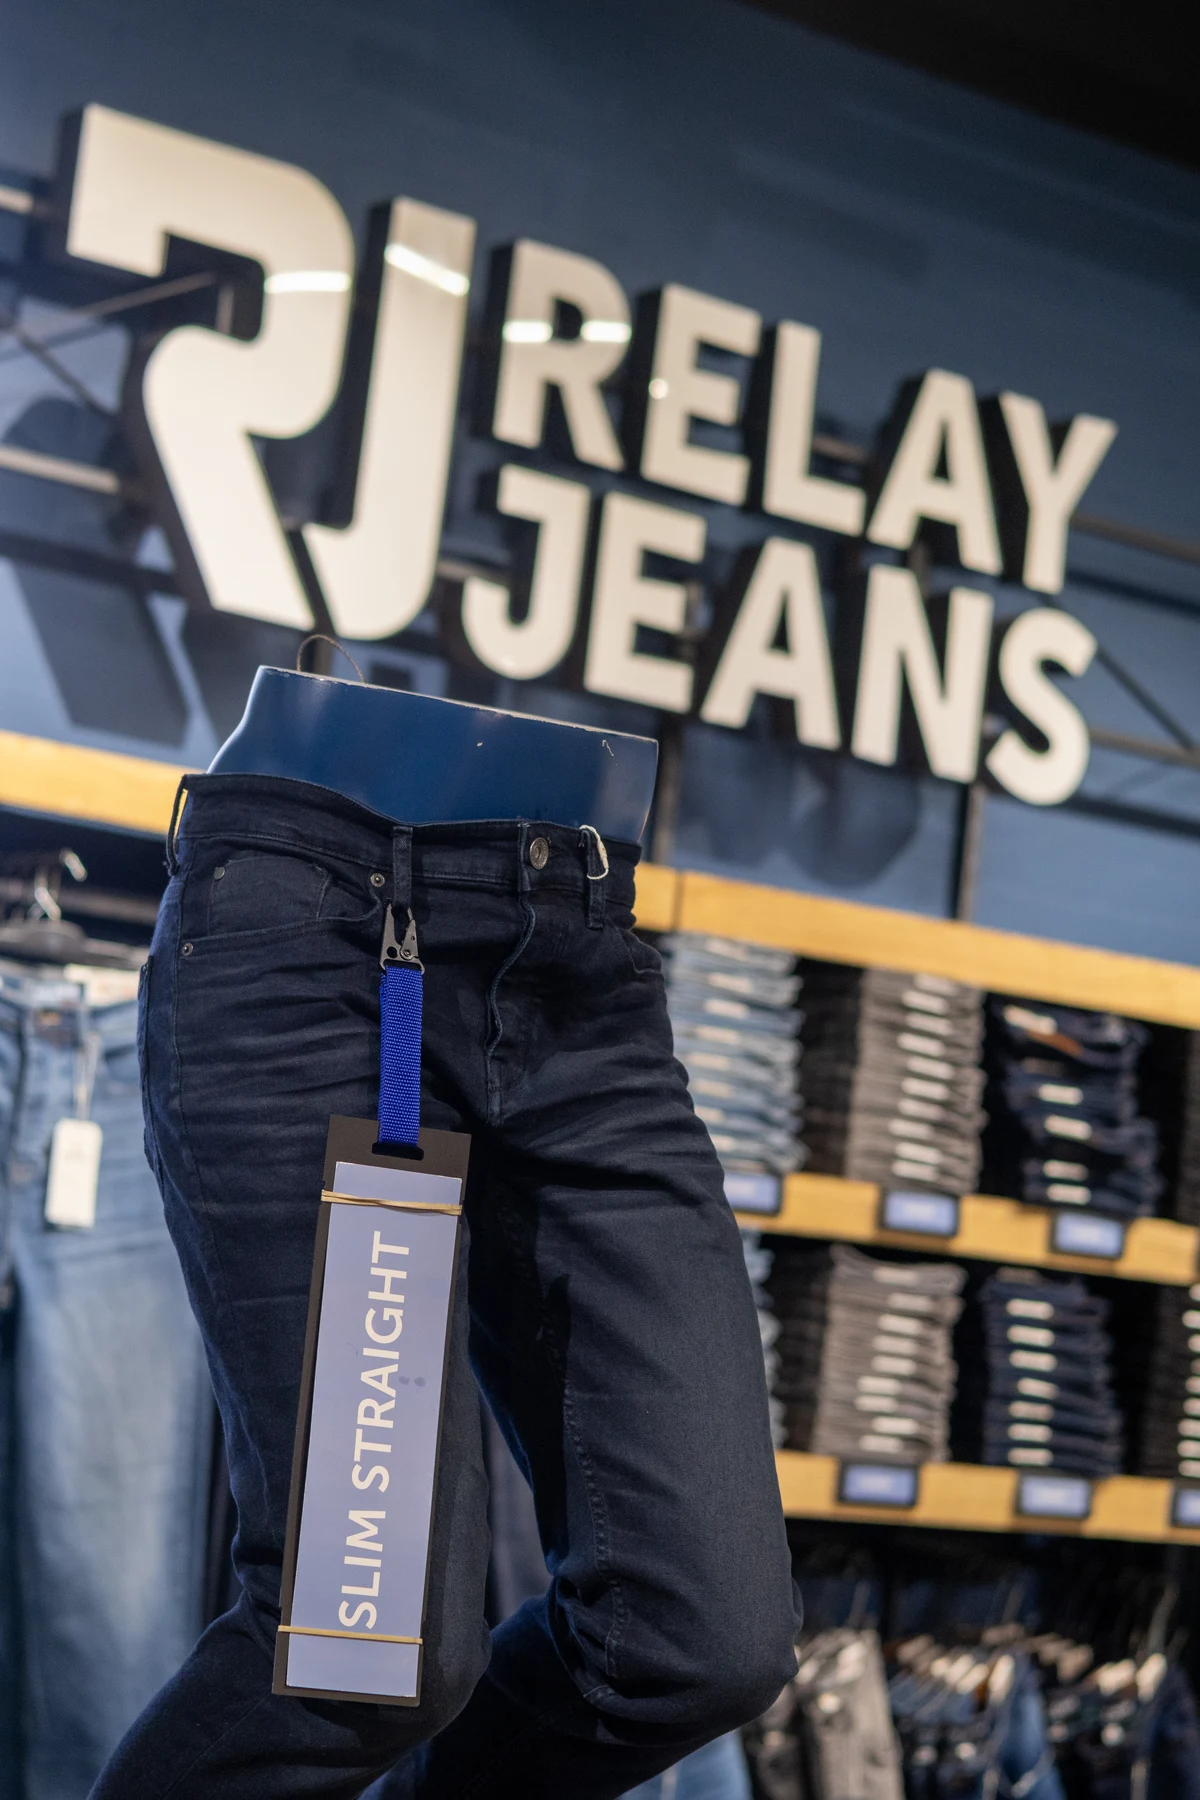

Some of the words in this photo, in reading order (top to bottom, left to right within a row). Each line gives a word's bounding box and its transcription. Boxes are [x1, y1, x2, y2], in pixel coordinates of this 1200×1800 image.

[67, 102, 477, 641] RJ
[493, 238, 1118, 594] RELAY
[462, 464, 1097, 805] JEANS
[351, 1230, 411, 1493] STRAIGHT
[338, 1510, 387, 1630] SLIM
